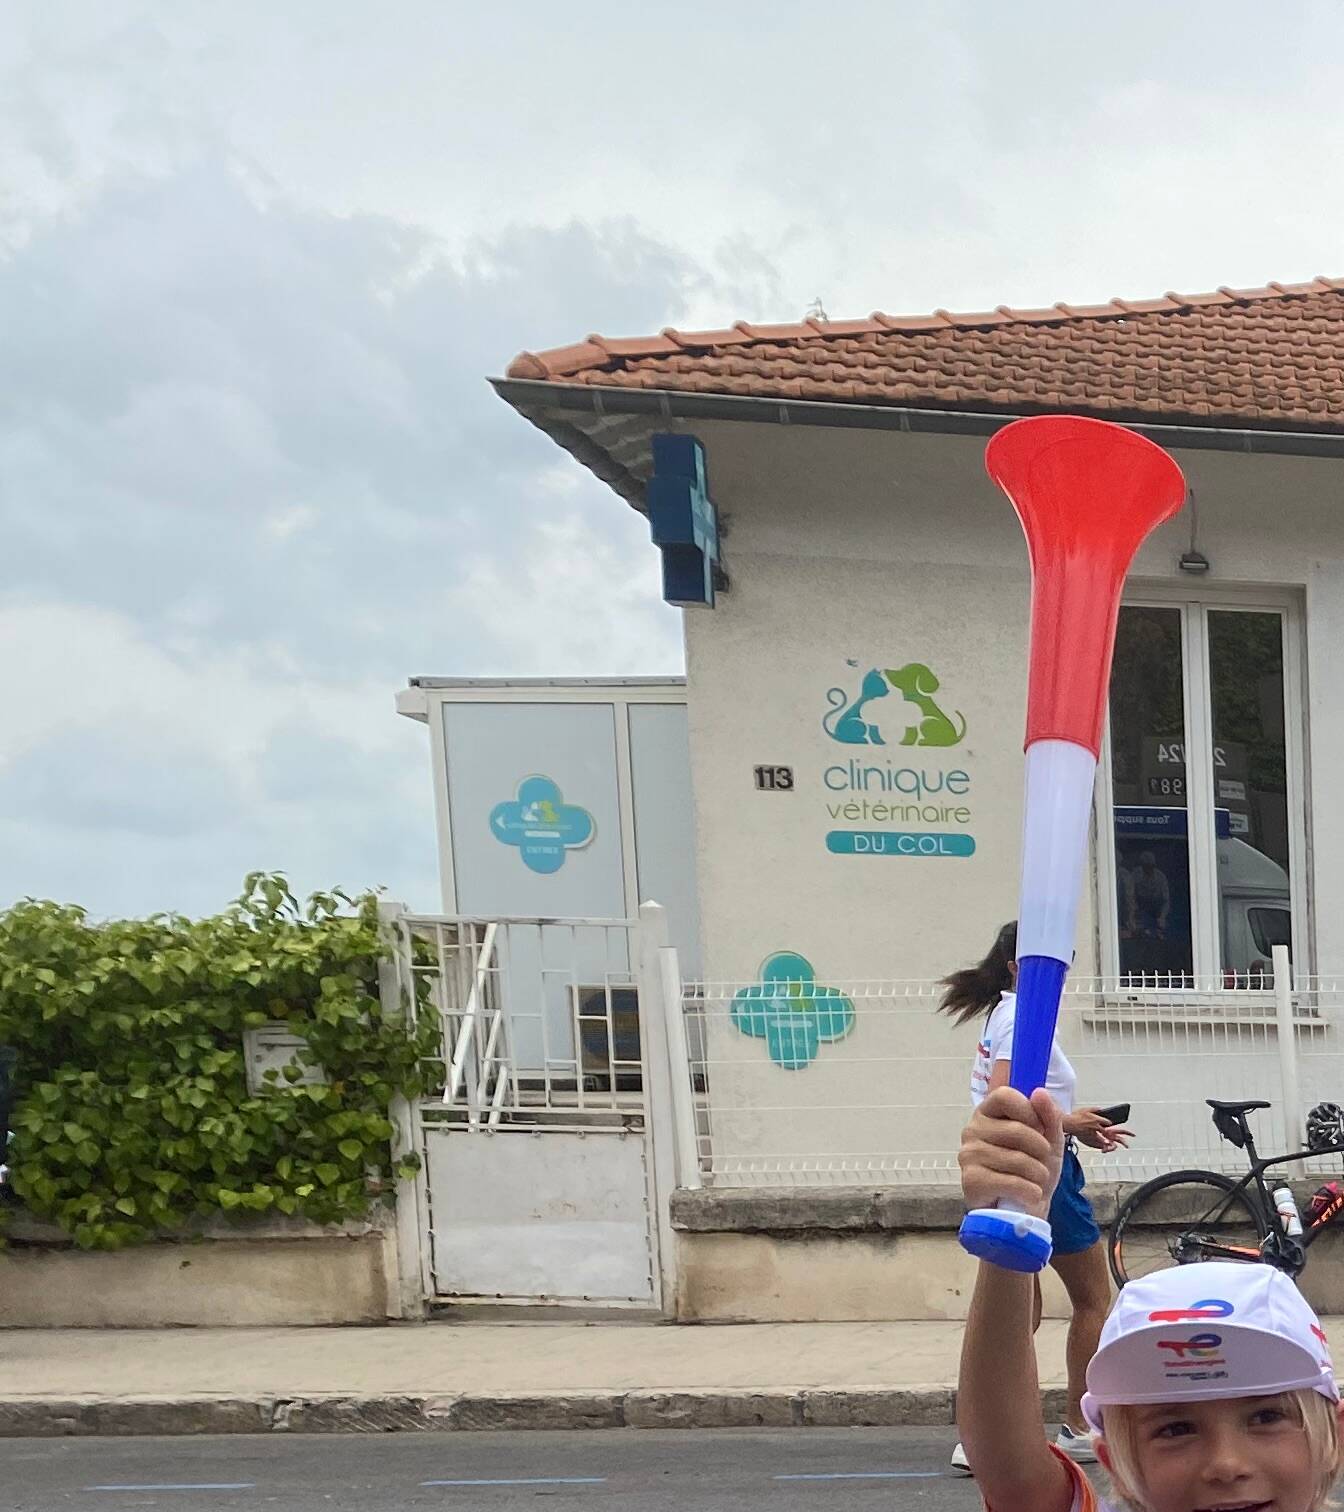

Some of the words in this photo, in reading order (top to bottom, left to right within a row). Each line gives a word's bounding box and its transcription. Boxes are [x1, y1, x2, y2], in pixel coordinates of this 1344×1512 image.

[754, 766, 794, 790] 113
[823, 759, 970, 801] clinique
[826, 798, 972, 824] vétérinaire
[853, 834, 885, 853] DU
[897, 835, 953, 854] COL
